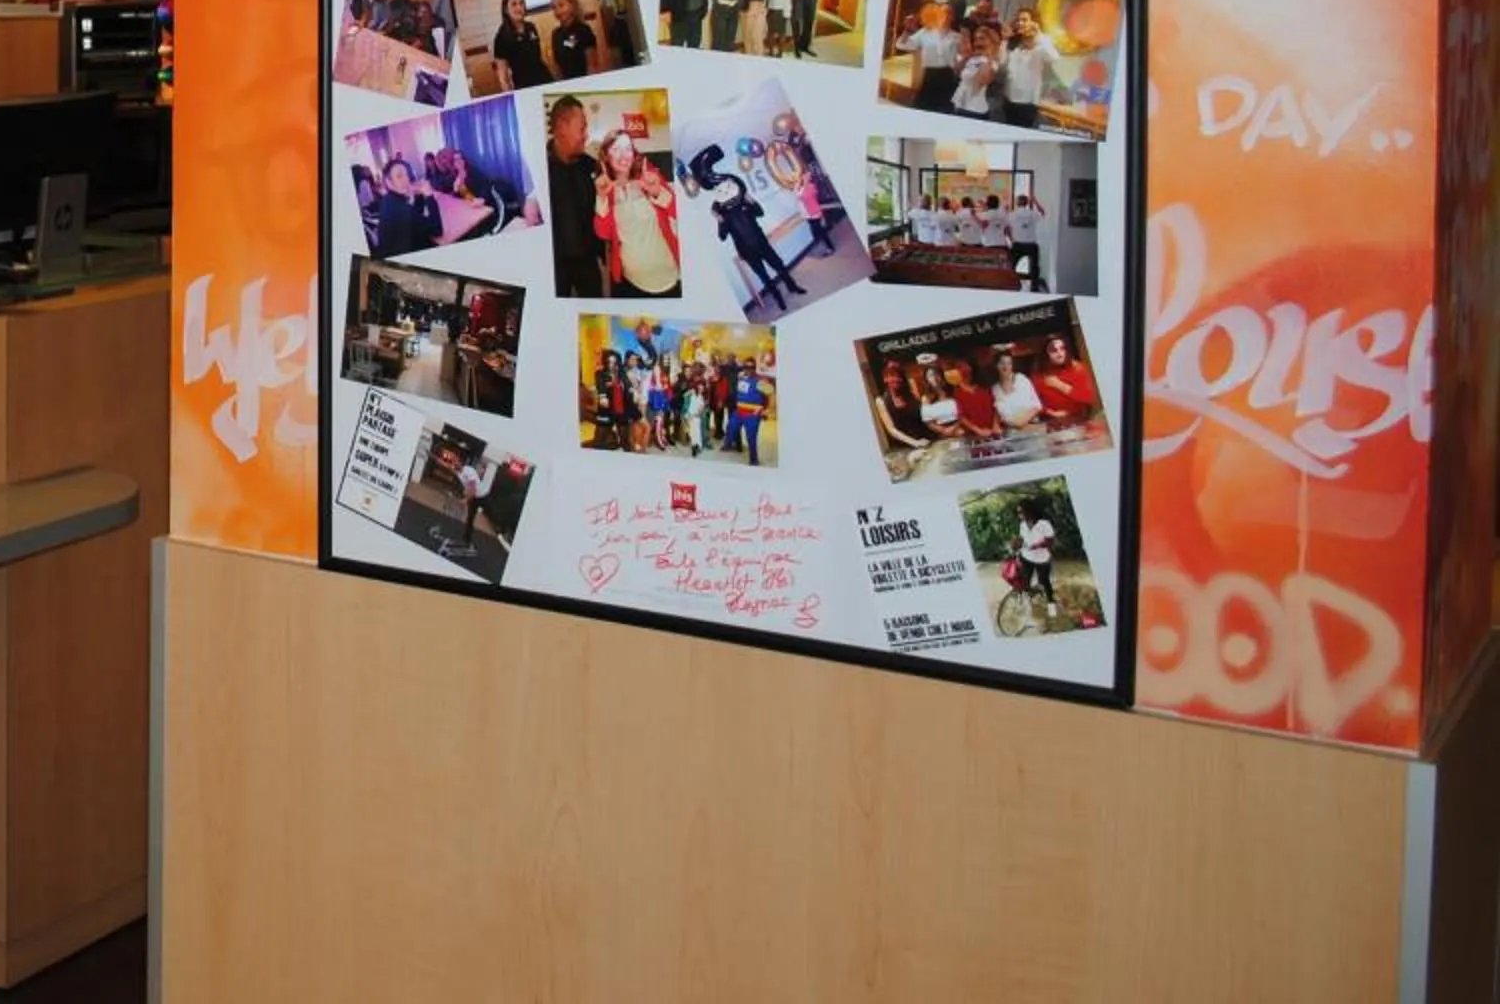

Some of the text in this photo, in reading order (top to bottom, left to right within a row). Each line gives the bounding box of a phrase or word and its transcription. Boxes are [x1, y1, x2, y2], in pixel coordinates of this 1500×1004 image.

[941, 324, 974, 340] DANS
[975, 319, 993, 335] LA
[859, 518, 922, 548] LOISIRS
